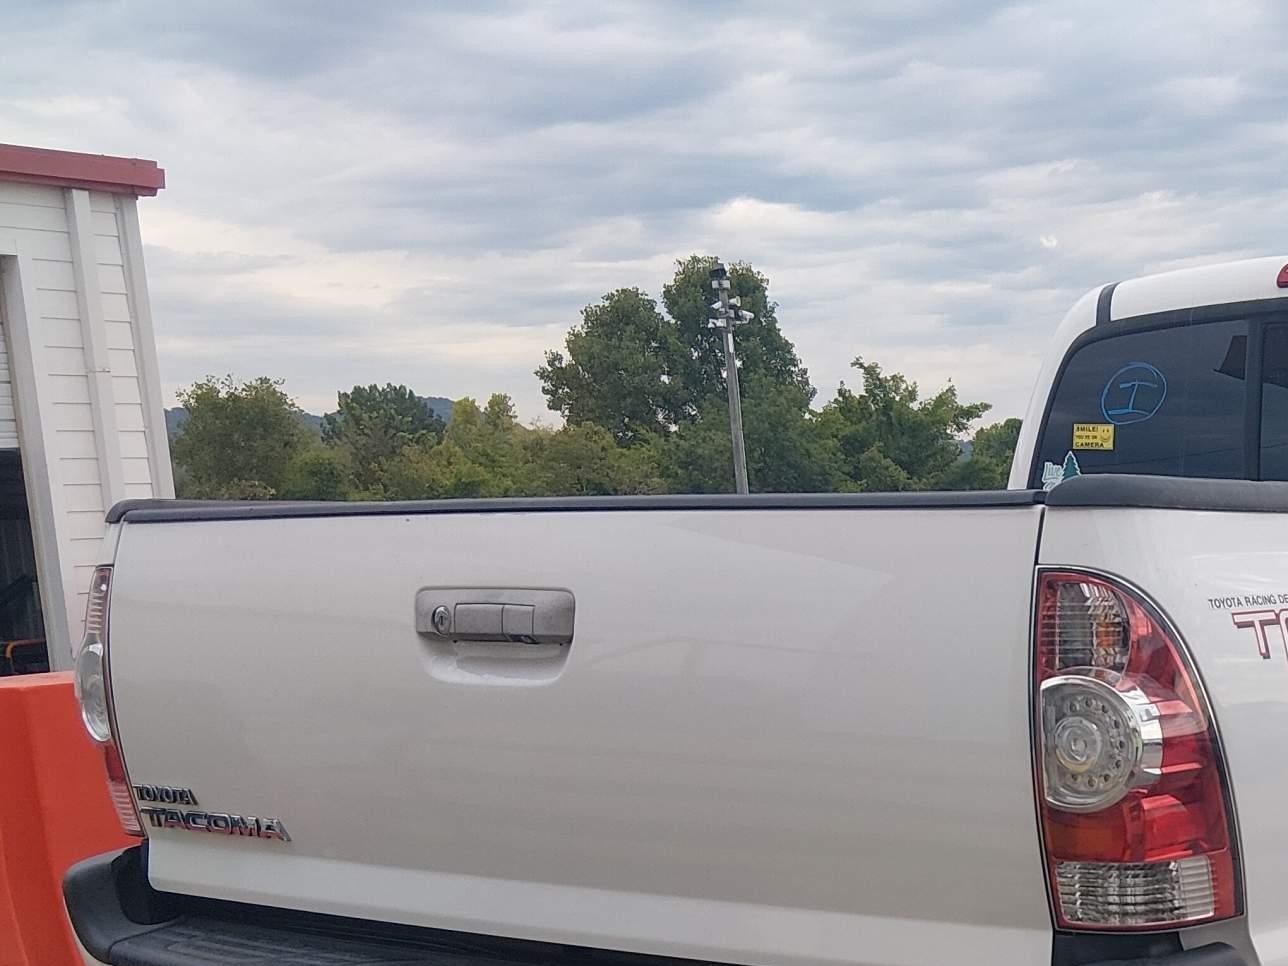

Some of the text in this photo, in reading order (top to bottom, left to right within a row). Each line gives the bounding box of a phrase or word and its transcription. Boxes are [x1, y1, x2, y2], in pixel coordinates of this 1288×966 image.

[1207, 596, 1244, 609] TOYOTA
[1244, 594, 1277, 608] RACING
[133, 784, 199, 805] TOYOTA
[139, 806, 292, 842] TACOMA
